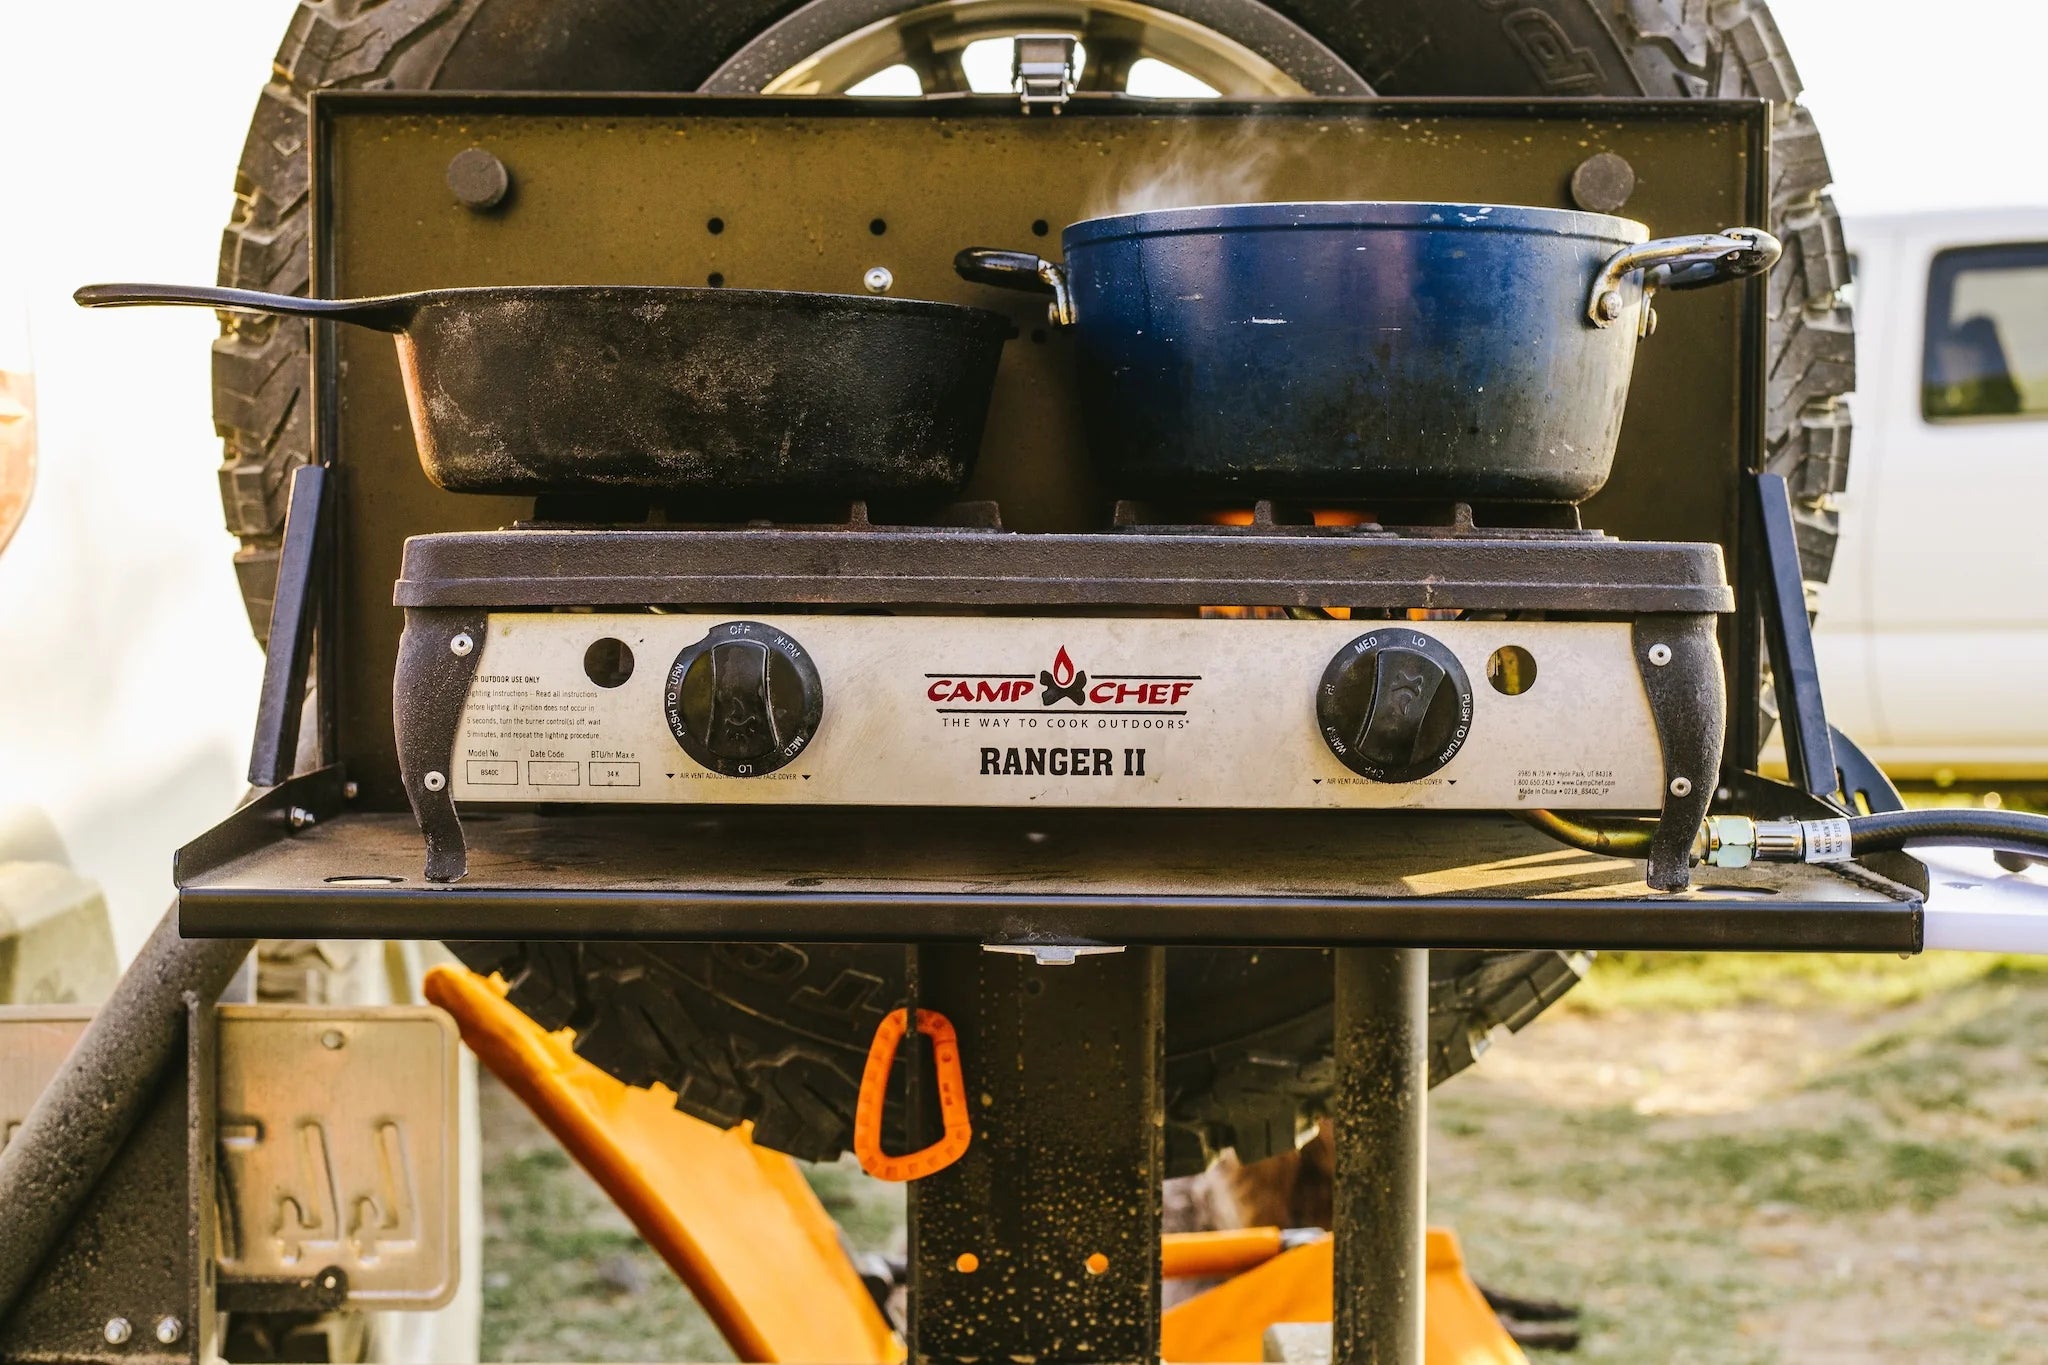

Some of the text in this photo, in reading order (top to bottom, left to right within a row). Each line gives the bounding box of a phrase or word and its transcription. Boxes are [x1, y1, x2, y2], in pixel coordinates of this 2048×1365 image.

[729, 623, 751, 636] OFF
[1354, 636, 1379, 654] MED
[1411, 635, 1427, 648] LO
[481, 675, 510, 683] OUTDOOR
[511, 675, 524, 683] USE
[525, 675, 541, 683] ONLY
[536, 690, 552, 698] Read
[553, 690, 561, 698] all
[927, 680, 1194, 705] CAMP CHEF
[667, 662, 686, 738] PUSH TO TURN
[514, 717, 524, 725] the
[588, 718, 601, 726] wait
[942, 718, 970, 728] THE
[979, 718, 1011, 728] WAY
[1019, 718, 1038, 728] TO
[1047, 718, 1090, 729] COOK
[1439, 693, 1472, 764] PUSH TO TURN
[467, 730, 471, 738] 5
[513, 731, 532, 739] repeat
[534, 731, 544, 739] the
[545, 731, 569, 740] lighting
[783, 735, 805, 757] MED
[468, 749, 488, 757] Model
[530, 750, 565, 758] Date Code
[591, 750, 614, 759] BTU/hr
[615, 750, 630, 759] Max
[980, 747, 1146, 776] RANGER II
[738, 764, 753, 774] LO
[1558, 769, 1571, 778] Hyde
[1587, 770, 1594, 778] UT
[779, 773, 797, 781] COVER
